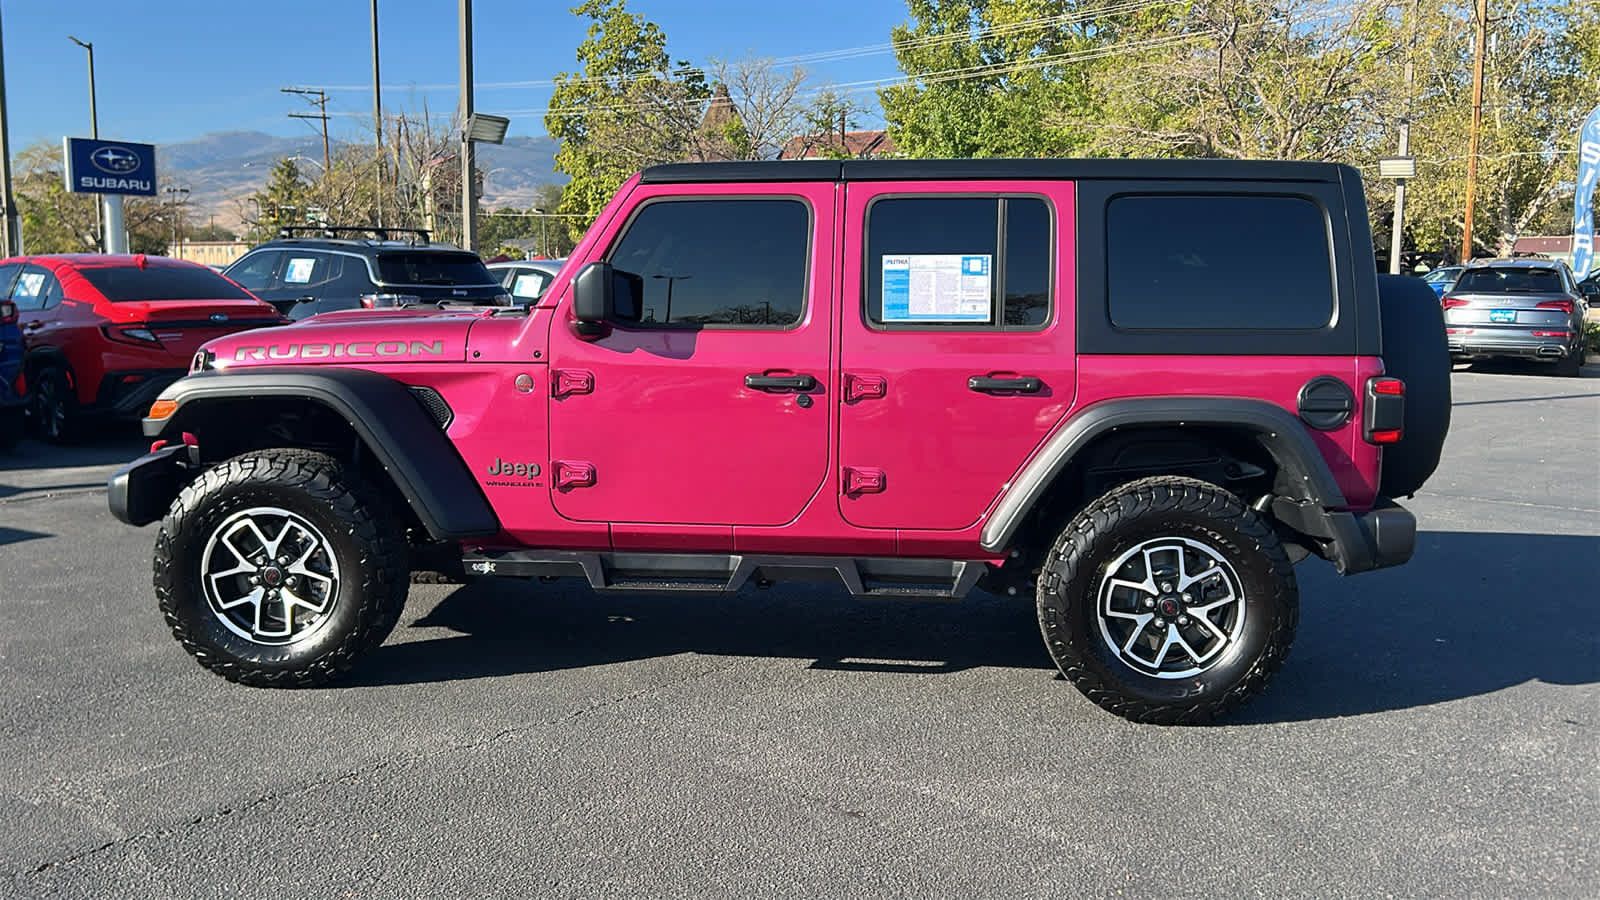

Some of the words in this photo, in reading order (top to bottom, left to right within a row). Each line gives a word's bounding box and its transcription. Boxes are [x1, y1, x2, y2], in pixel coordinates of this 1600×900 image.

[81, 176, 150, 191] SUBARU
[234, 340, 444, 361] RUBICON
[487, 457, 542, 480] Jeep
